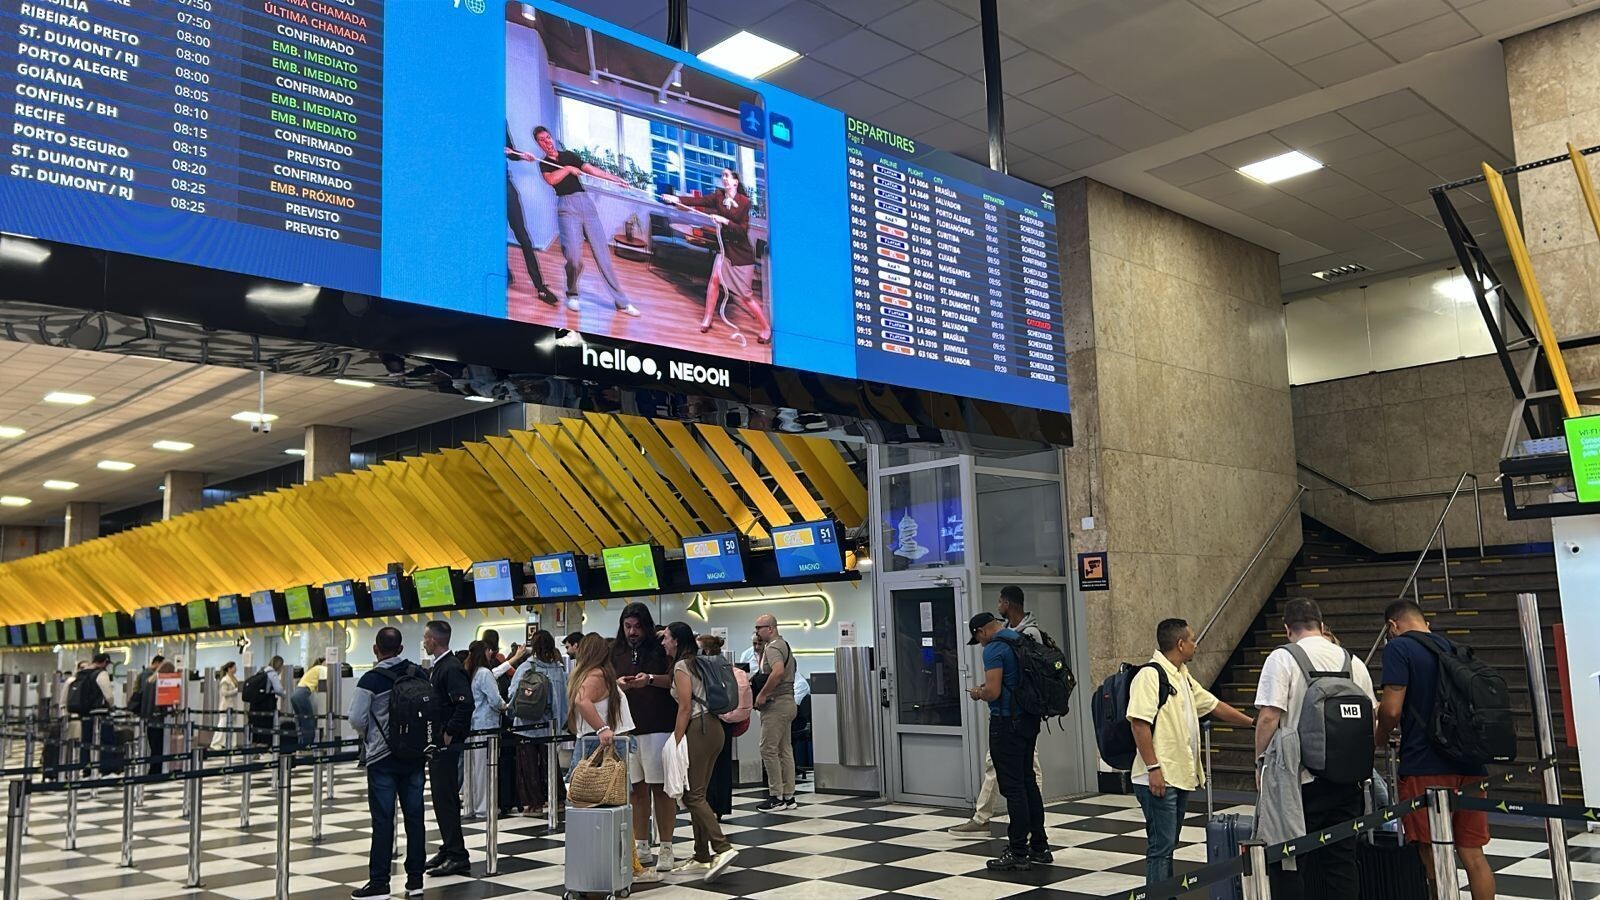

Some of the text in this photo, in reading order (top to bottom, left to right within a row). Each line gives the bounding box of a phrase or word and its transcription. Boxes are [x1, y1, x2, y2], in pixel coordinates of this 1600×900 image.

[264, 2, 367, 44] ÚLTIMA CHAMADA
[311, 2, 367, 28] CHAMADA
[21, 3, 354, 106] RIBEIRÃO PRETO 08:00 CONFIRMADO
[178, 12, 358, 74] 07:50 EMB. IMEDIATO
[277, 24, 354, 56] CONFIRMADO
[19, 24, 41, 39] ST.
[45, 30, 113, 58] DUMONT
[124, 52, 139, 67] RJ
[176, 67, 209, 84] 08:00
[272, 92, 300, 109] EMB.
[303, 102, 357, 124] IMEDIATO
[177, 30, 210, 48] 08:00
[272, 58, 301, 74] EMB.
[304, 66, 358, 90] IMEDIATO
[17, 63, 353, 157] GOIÂNIA 08:10 CONFIRMADO
[18, 43, 357, 140] PORTO ALEGRE 08:05 EMB. IMEDIATO
[16, 84, 84, 109] CONFINS
[97, 103, 118, 118] BH
[174, 122, 208, 139] 08:15
[287, 150, 341, 171] PREVISTO
[848, 118, 915, 153] DEPARTURES
[15, 103, 352, 191] RECIFE 08:15 CONFIRMADO
[12, 144, 34, 158] ST.
[38, 149, 108, 173] DUMONT
[120, 167, 134, 181] RJ
[172, 178, 206, 194] 08:25
[286, 202, 340, 223] PREVISTO
[14, 123, 355, 209] PORTO SEGURO 08:20 EMB. PRÓXIMO
[848, 146, 862, 157] HORA
[880, 158, 897, 169] AIRLINE
[908, 168, 923, 178] FLIGHT
[934, 177, 943, 185] CITY
[1024, 208, 1038, 218] STATUS
[11, 164, 33, 178] ST.
[37, 169, 107, 193] DUMONT
[119, 186, 133, 200] RJ
[171, 197, 205, 213] 08:25
[285, 220, 340, 240] PREVISTO
[935, 186, 957, 199] BRASÍLIA
[1020, 214, 1044, 228] SCHEDULED
[936, 197, 961, 210] SALVADOR
[1020, 225, 1045, 238] SCHEDULED
[936, 208, 952, 219] PORTO
[953, 214, 971, 225] ALEGRE
[1021, 235, 1045, 248] SCHEDULED
[937, 219, 974, 237] FLORIANÓPOLIS
[1022, 246, 1046, 258] SCHEDULED
[937, 231, 960, 243] CURITIBA
[1022, 256, 1047, 268] CONFIRMED
[938, 242, 960, 254] CURITIBA
[1023, 267, 1048, 279] SCHEDULED
[939, 264, 971, 278] NAVEGANTES
[1024, 288, 1049, 299] SCHEDULED
[940, 276, 956, 286] RECIFE
[1025, 298, 1050, 310] SCHEDULED
[1024, 277, 1048, 289] SCHEDULED
[948, 289, 970, 300] DUMONT
[1026, 308, 1051, 320] SCHEDULED
[949, 300, 971, 311] DUMONT
[942, 310, 958, 319] PORTO
[959, 315, 977, 324] ALEGRE
[1027, 330, 1052, 340] SCHEDULED
[942, 321, 968, 332] SALVADOR
[1028, 340, 1053, 351] SCHEDULED
[943, 332, 965, 343] BRASÍLIA
[1029, 351, 1054, 361] SCHEDULED
[944, 344, 968, 354] JOINVILLE
[1030, 361, 1055, 372] SCHEDULED
[670, 360, 730, 387] NEOOH
[944, 356, 971, 366] SALVADOR
[1030, 372, 1055, 382] SCHEDULED
[726, 541, 735, 550] 50
[821, 528, 831, 538] 51
[1343, 706, 1358, 716] MB
